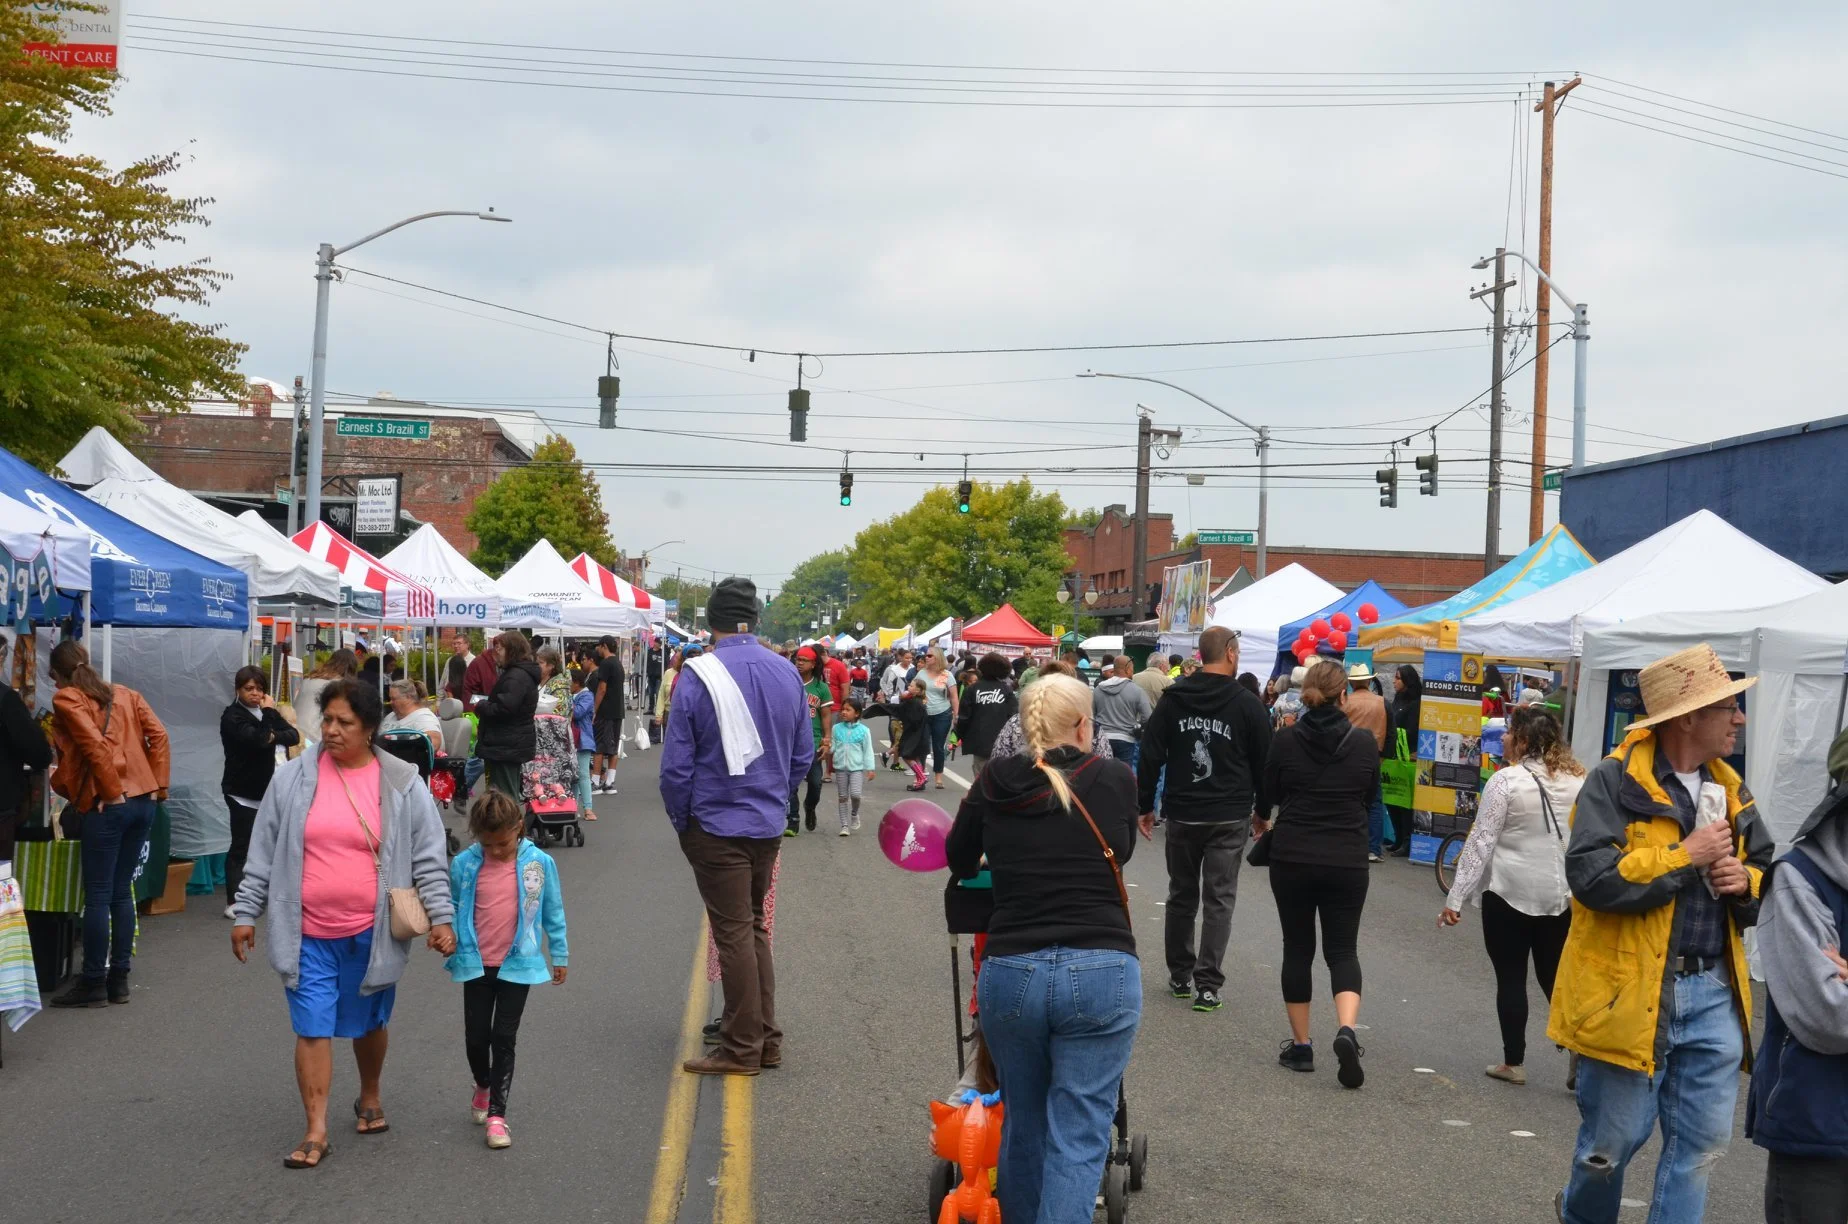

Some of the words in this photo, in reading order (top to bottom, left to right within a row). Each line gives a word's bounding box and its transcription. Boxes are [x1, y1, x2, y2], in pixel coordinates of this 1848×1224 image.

[71, 23, 112, 33] DENTAL
[22, 49, 70, 62] RGENT
[73, 51, 112, 63] CARE
[339, 421, 374, 433] Earnest
[377, 422, 383, 434] S
[386, 423, 414, 435] Brazill
[419, 425, 428, 434] ST
[1199, 534, 1221, 542] Earnest
[1221, 534, 1227, 542] S
[1425, 681, 1453, 690] SECOND
[1454, 684, 1477, 693] CYCLE
[1178, 716, 1232, 740] TACOMA
